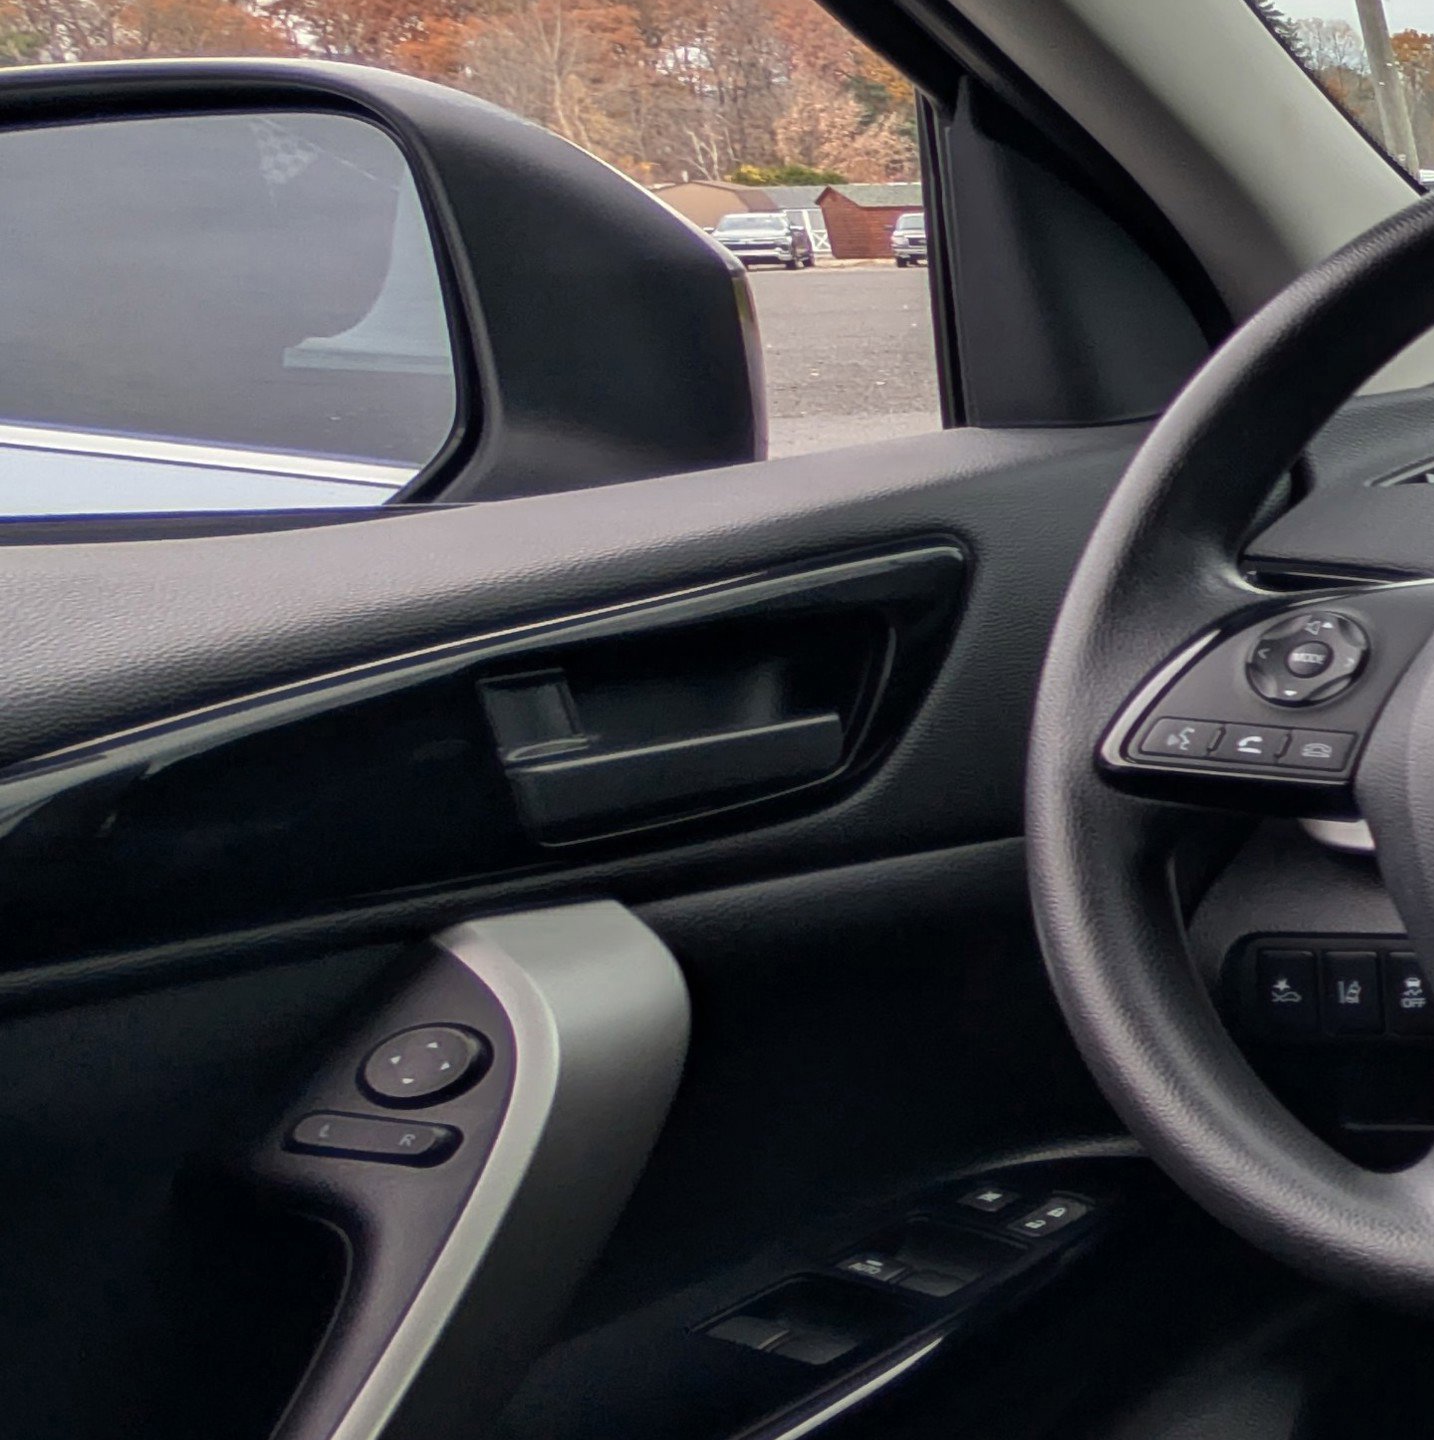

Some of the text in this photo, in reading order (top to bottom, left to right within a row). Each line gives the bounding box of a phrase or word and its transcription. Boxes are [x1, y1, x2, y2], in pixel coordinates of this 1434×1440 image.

[1400, 997, 1427, 1009] OFF
[319, 1123, 330, 1138] L
[399, 1132, 416, 1146] R
